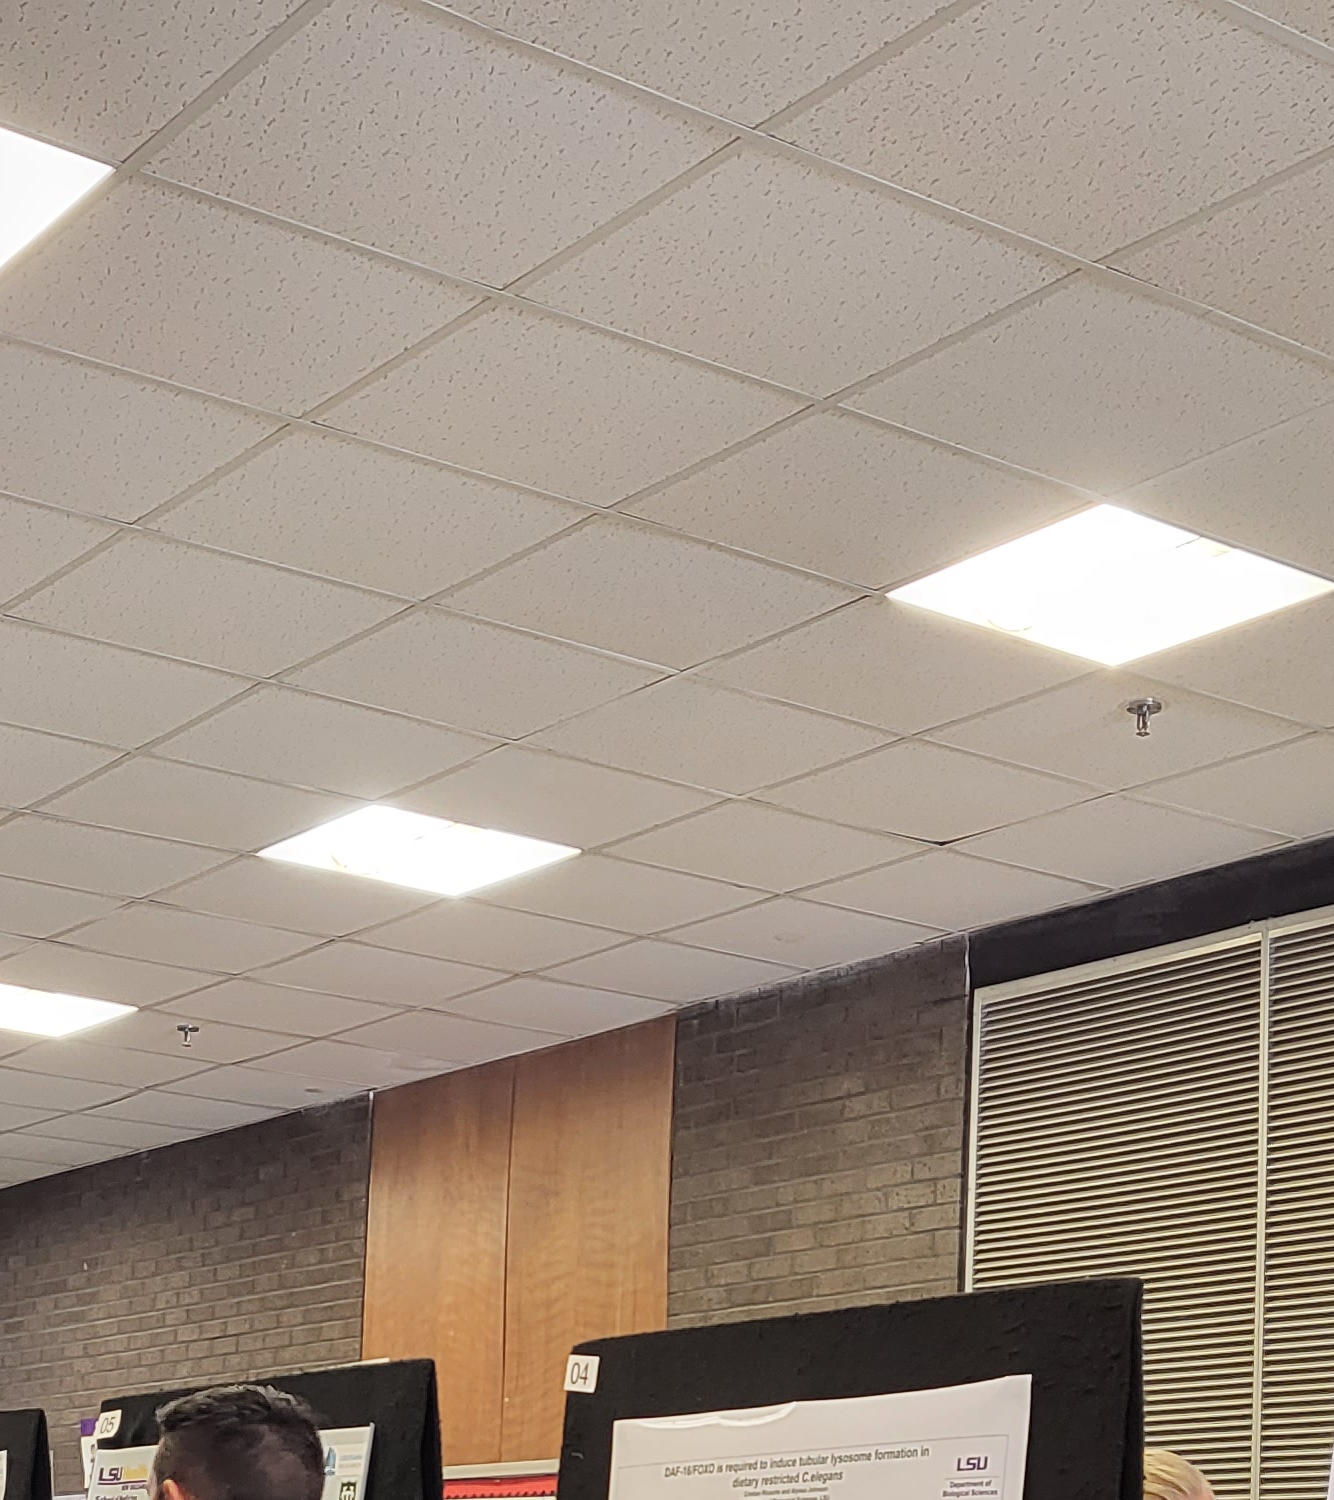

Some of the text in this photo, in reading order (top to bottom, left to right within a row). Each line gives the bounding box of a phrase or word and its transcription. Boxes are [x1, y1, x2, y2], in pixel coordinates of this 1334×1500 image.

[570, 1362, 589, 1384] 04
[100, 1417, 115, 1433] 05
[725, 1460, 757, 1473] required
[760, 1459, 767, 1469] to
[770, 1458, 797, 1468] induce
[800, 1454, 829, 1466] tubular
[831, 1452, 872, 1466] lysosome
[875, 1447, 918, 1460] formation
[921, 1446, 929, 1457] in
[957, 1456, 988, 1471] LSU
[99, 1467, 123, 1481] LSU
[733, 1475, 759, 1488] dietary
[761, 1473, 799, 1485] restricted
